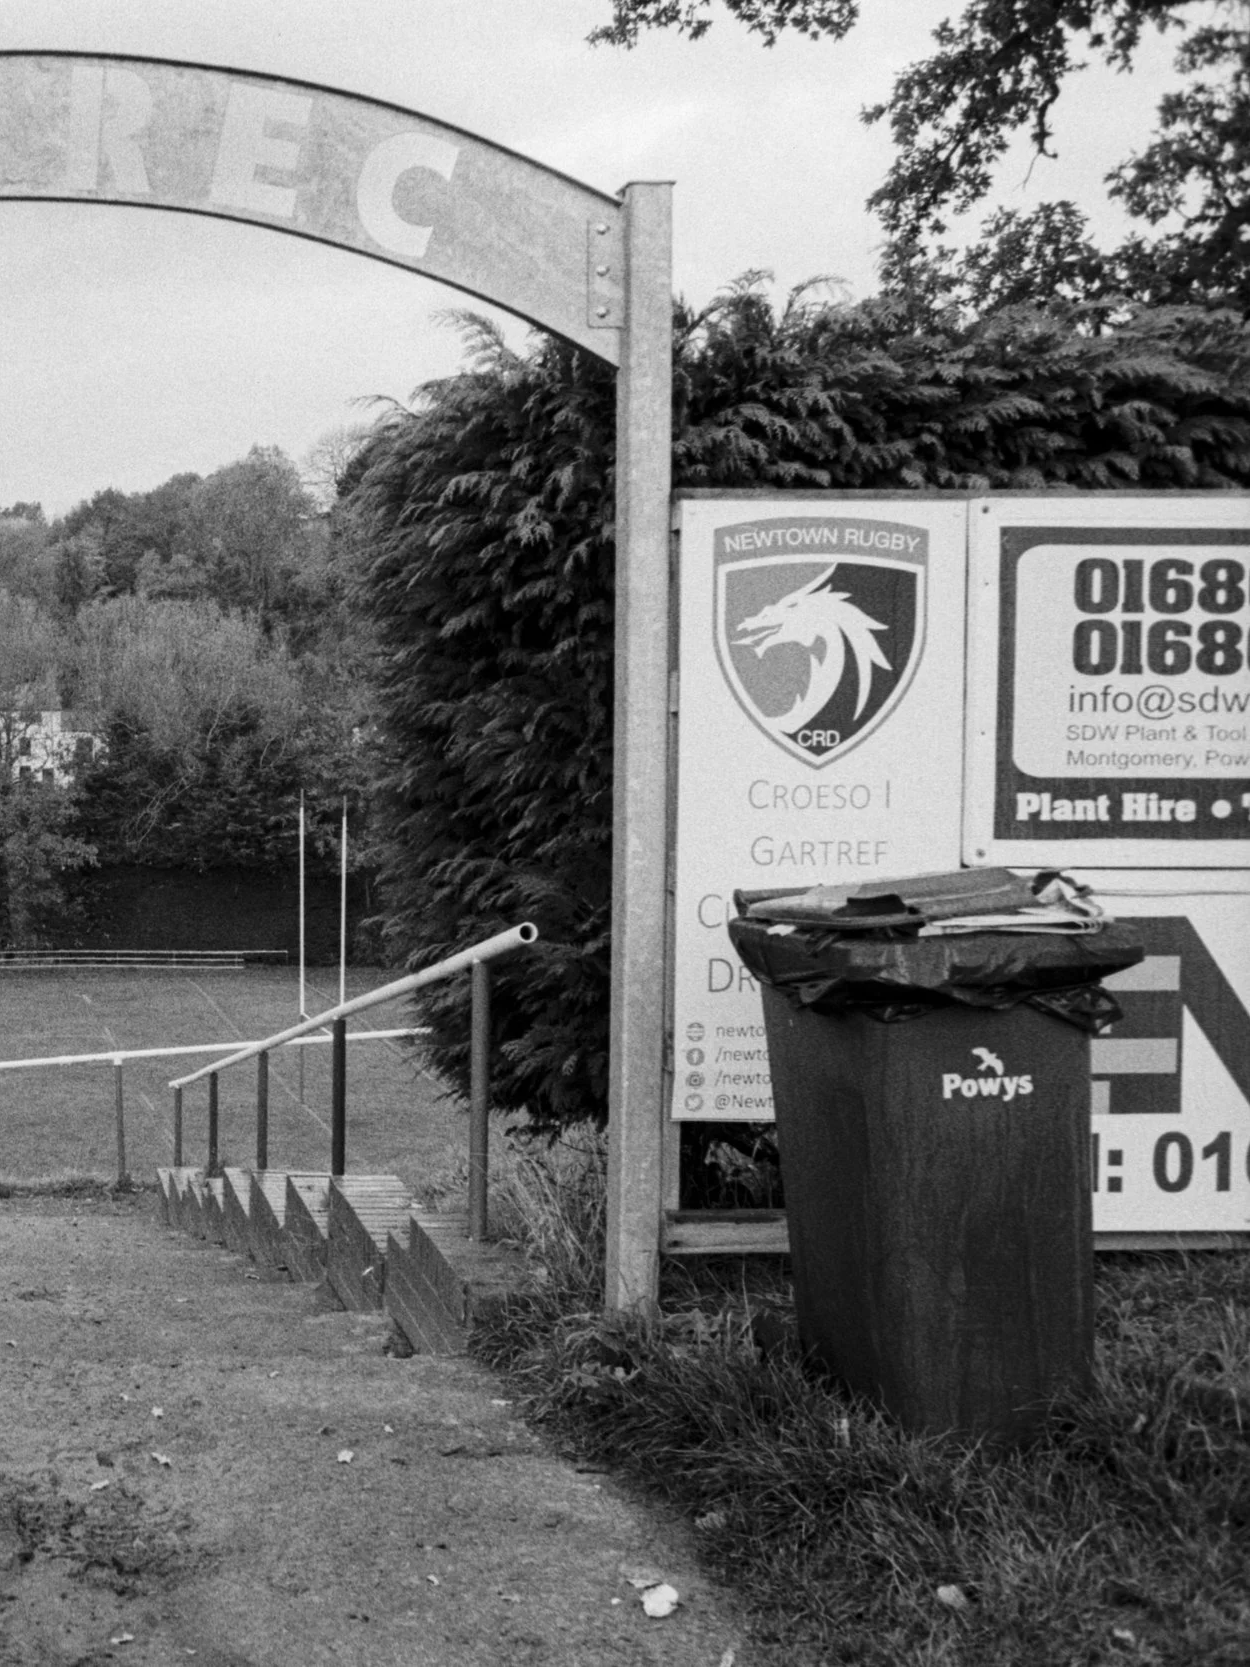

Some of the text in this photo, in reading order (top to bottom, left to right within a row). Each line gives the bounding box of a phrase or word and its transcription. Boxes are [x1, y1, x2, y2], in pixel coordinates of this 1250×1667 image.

[67, 64, 461, 258] REC
[725, 528, 921, 551] NEWTOWN RUGBY
[1074, 557, 1250, 615] 0168
[1072, 618, 1250, 676] 0168
[1069, 684, 1250, 720] info@sdw
[798, 730, 840, 747] CRD
[1066, 724, 1247, 742] SDW Plant & Tool
[1016, 792, 1197, 822] Plant Hire
[942, 1073, 1034, 1102] Powys
[1152, 1131, 1250, 1193] 01
